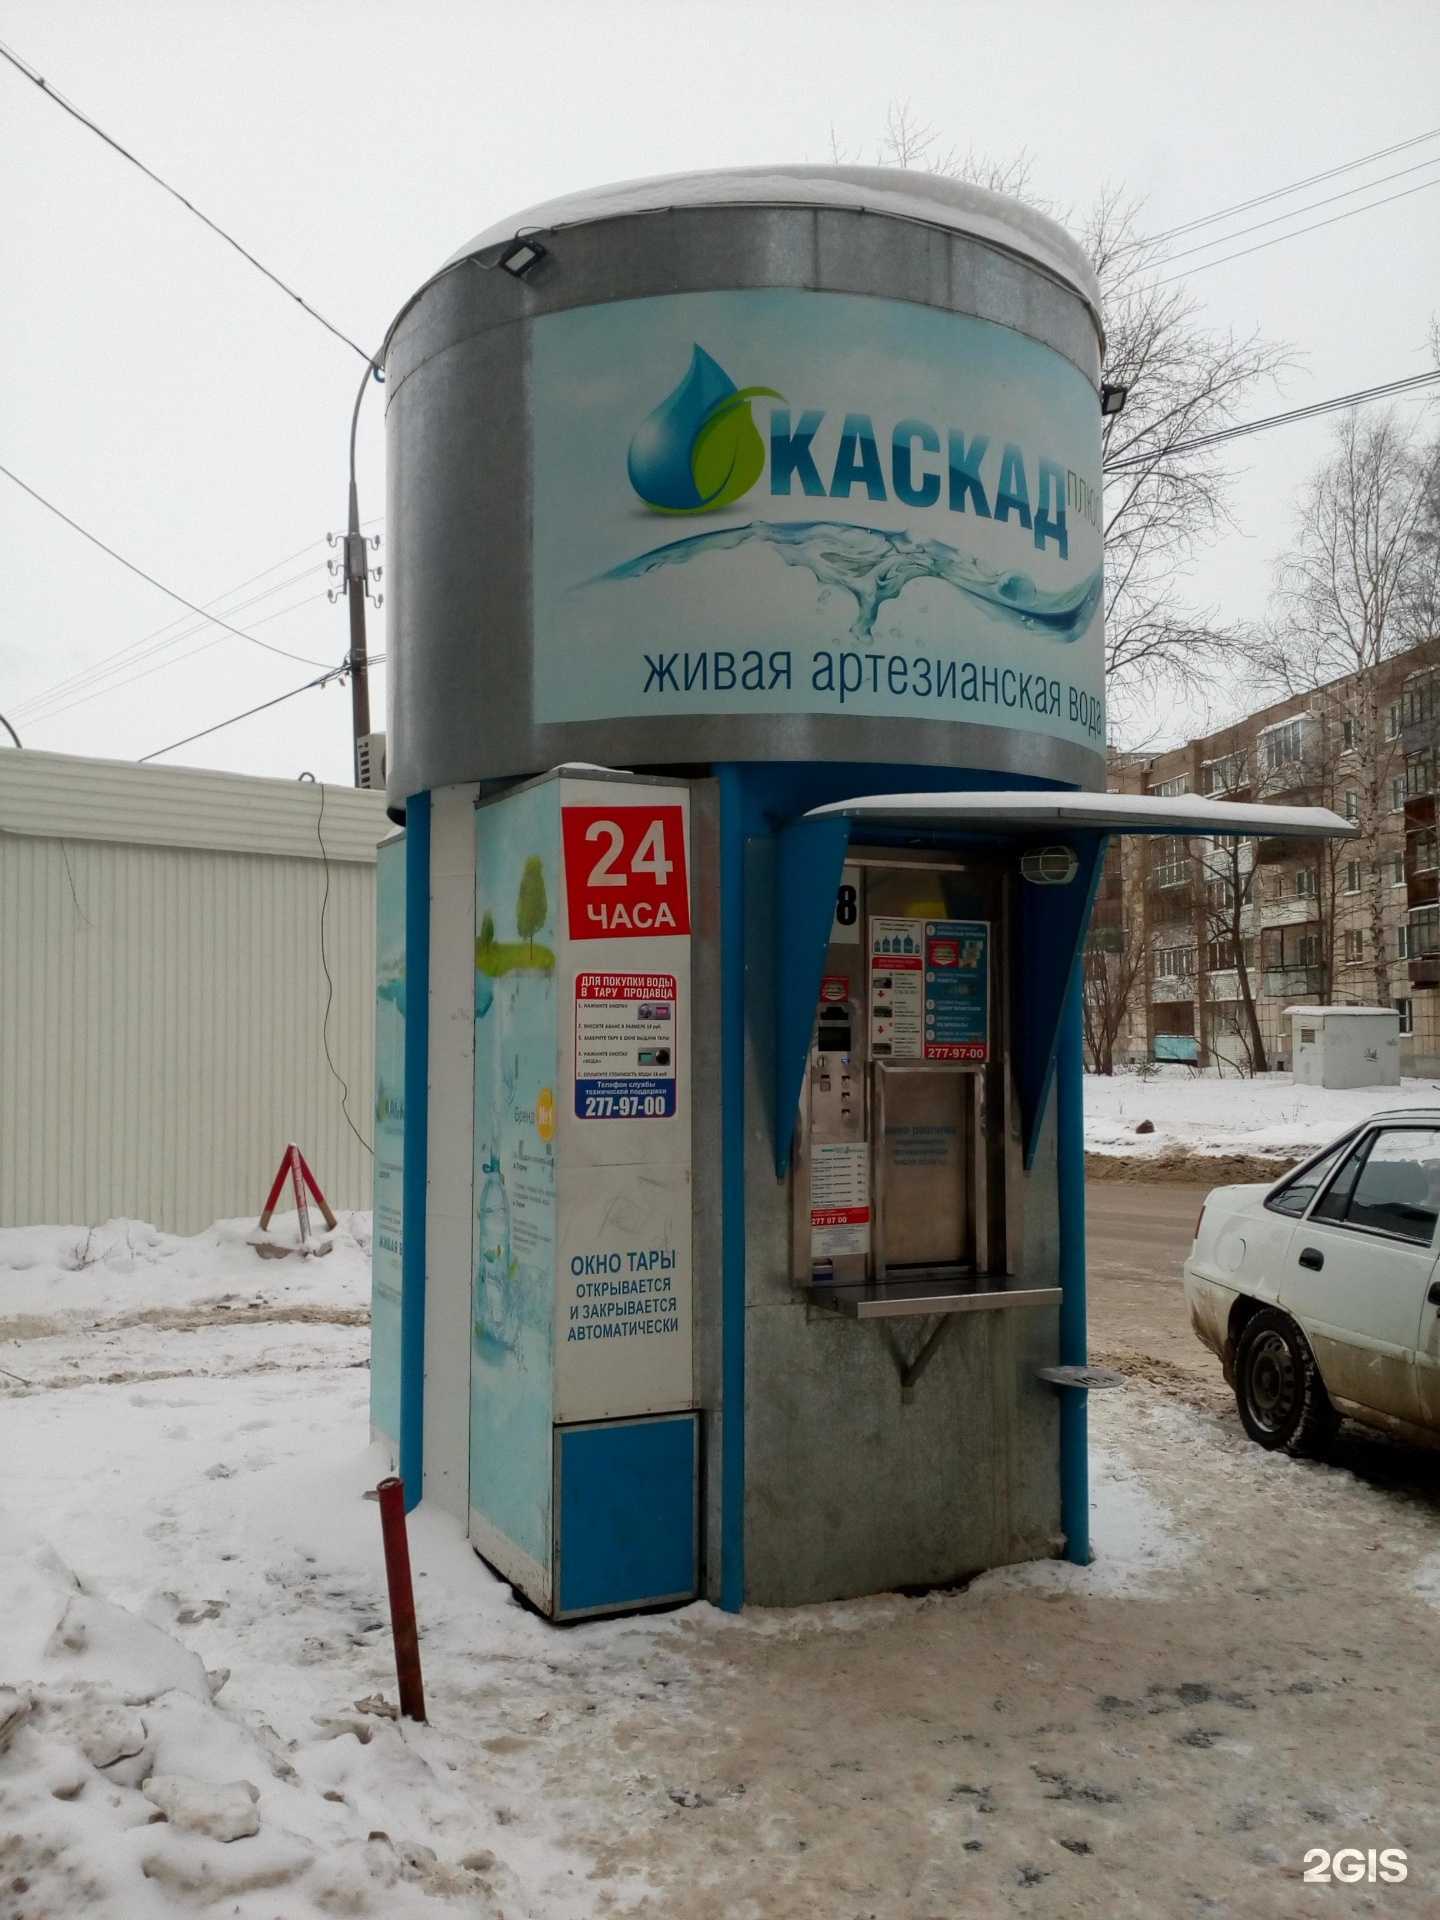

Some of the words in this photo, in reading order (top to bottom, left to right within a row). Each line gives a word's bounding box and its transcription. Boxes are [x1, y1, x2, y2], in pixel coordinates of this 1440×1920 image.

[770, 407, 1068, 560] КАСКАД
[642, 649, 792, 694] живая
[811, 649, 1061, 717] артезианская
[1068, 686, 1103, 742] вода
[585, 820, 674, 887] 24
[587, 902, 677, 929] ЧАСА
[581, 976, 601, 987] ДЛЯ
[603, 976, 645, 987] ПОКУПКИ
[646, 977, 673, 989] ВОДЫ
[581, 987, 588, 997] В
[593, 987, 617, 998] ТАРУ
[623, 987, 673, 999] ПРОДАВЦА
[928, 1047, 984, 1059] 277-97-00
[585, 1097, 666, 1116] 277-97-00
[571, 1253, 622, 1276] ОКНО
[626, 1249, 677, 1272] ТАРЫ
[576, 1277, 671, 1298] ОТКРЫВАЕТСЯ
[570, 1305, 579, 1320] И
[583, 1297, 677, 1319] ЗАКРЫВАЕТСЯ
[567, 1318, 679, 1342] АВТОМАТИЧЕСКИ
